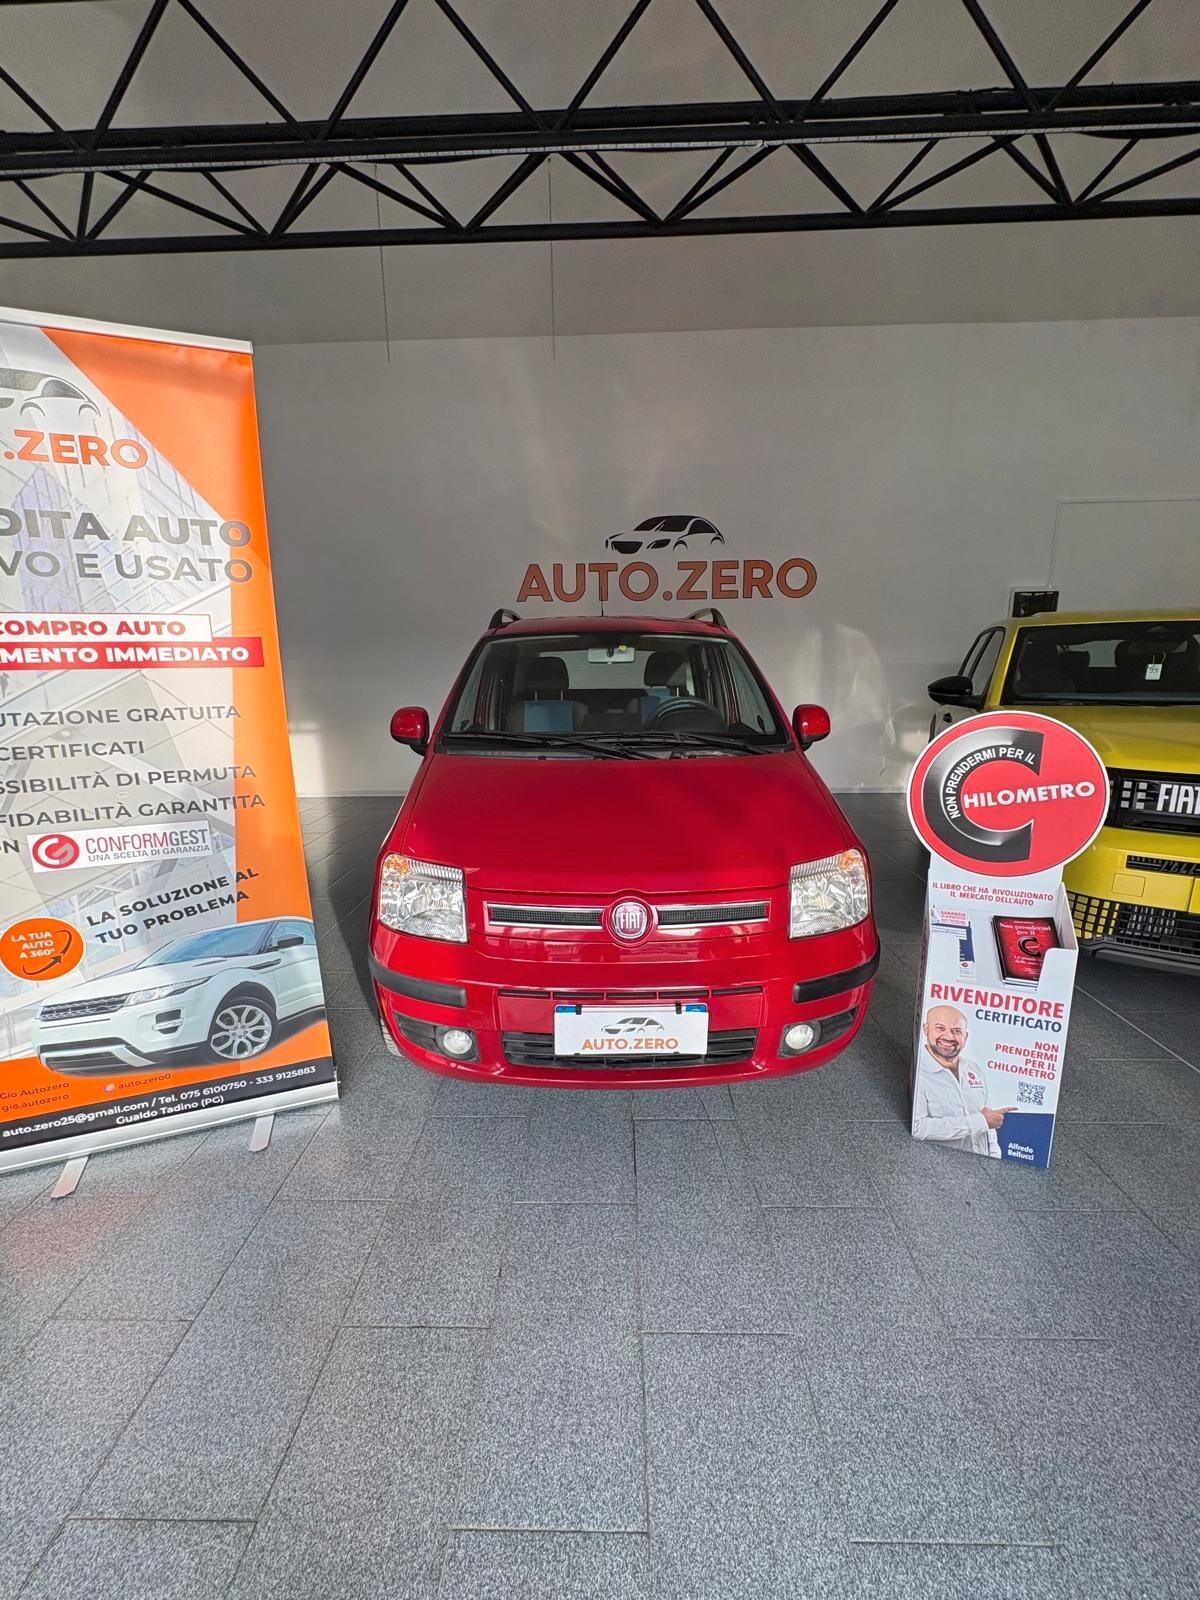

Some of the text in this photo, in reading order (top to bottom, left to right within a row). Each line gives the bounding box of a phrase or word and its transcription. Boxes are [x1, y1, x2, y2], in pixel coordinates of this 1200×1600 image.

[122, 514, 252, 548] AUTO
[75, 553, 103, 579] E
[115, 553, 253, 584] USATO
[516, 558, 818, 603] AUTO.ZERO
[0, 619, 187, 636] OMPRO AUTO
[106, 646, 250, 664] IMMEDIATO
[126, 705, 241, 723] GRATUITA
[116, 772, 141, 787] DI
[147, 764, 257, 785] PERMUTA
[945, 747, 1036, 820] NON PRENDERMI PER IL
[138, 794, 266, 817] GARANTITA
[1156, 783, 1200, 815] FIAT
[0, 840, 20, 854] N
[85, 828, 209, 854] CONFORMGEST
[87, 844, 210, 862] UNA SCELTA DI GARANZIA
[86, 867, 259, 927] LA SOLUZIONE AL
[940, 883, 962, 891] LIBRO
[962, 885, 977, 893] CHE
[978, 886, 989, 894] HA
[991, 887, 1054, 902] RIVOLUZIONATO
[950, 890, 1034, 906] IL MERCATO DELL'AUTO
[95, 891, 251, 944] TUO PROBLEMA
[620, 910, 642, 931] FIAT
[10, 931, 53, 942] LA TUA
[22, 940, 54, 950] AUTO
[930, 983, 1065, 1019] RIVENDITORE
[975, 1008, 1062, 1033] CERTIFICATO
[581, 1037, 679, 1050] AUTO.ZERO
[995, 1043, 1058, 1062] PRENDERMI
[1034, 1041, 1059, 1053] NON
[987, 1060, 1056, 1080] CHILOMETRO
[1025, 1058, 1057, 1072] PER IL
[0, 1081, 70, 1100] Gio Autozero
[2, 1101, 149, 1138] auto.zero25@gmail.com
[159, 1093, 178, 1105] Tel.
[180, 1089, 201, 1101] 075
[202, 1080, 247, 1096] 6100750
[255, 1074, 274, 1086] 333
[275, 1065, 317, 1081] 9125883
[115, 1095, 225, 1125] Gualdo Tadino (PG)
[1007, 1149, 1034, 1161] Bellucci
[1008, 1142, 1034, 1154] Alfredo
